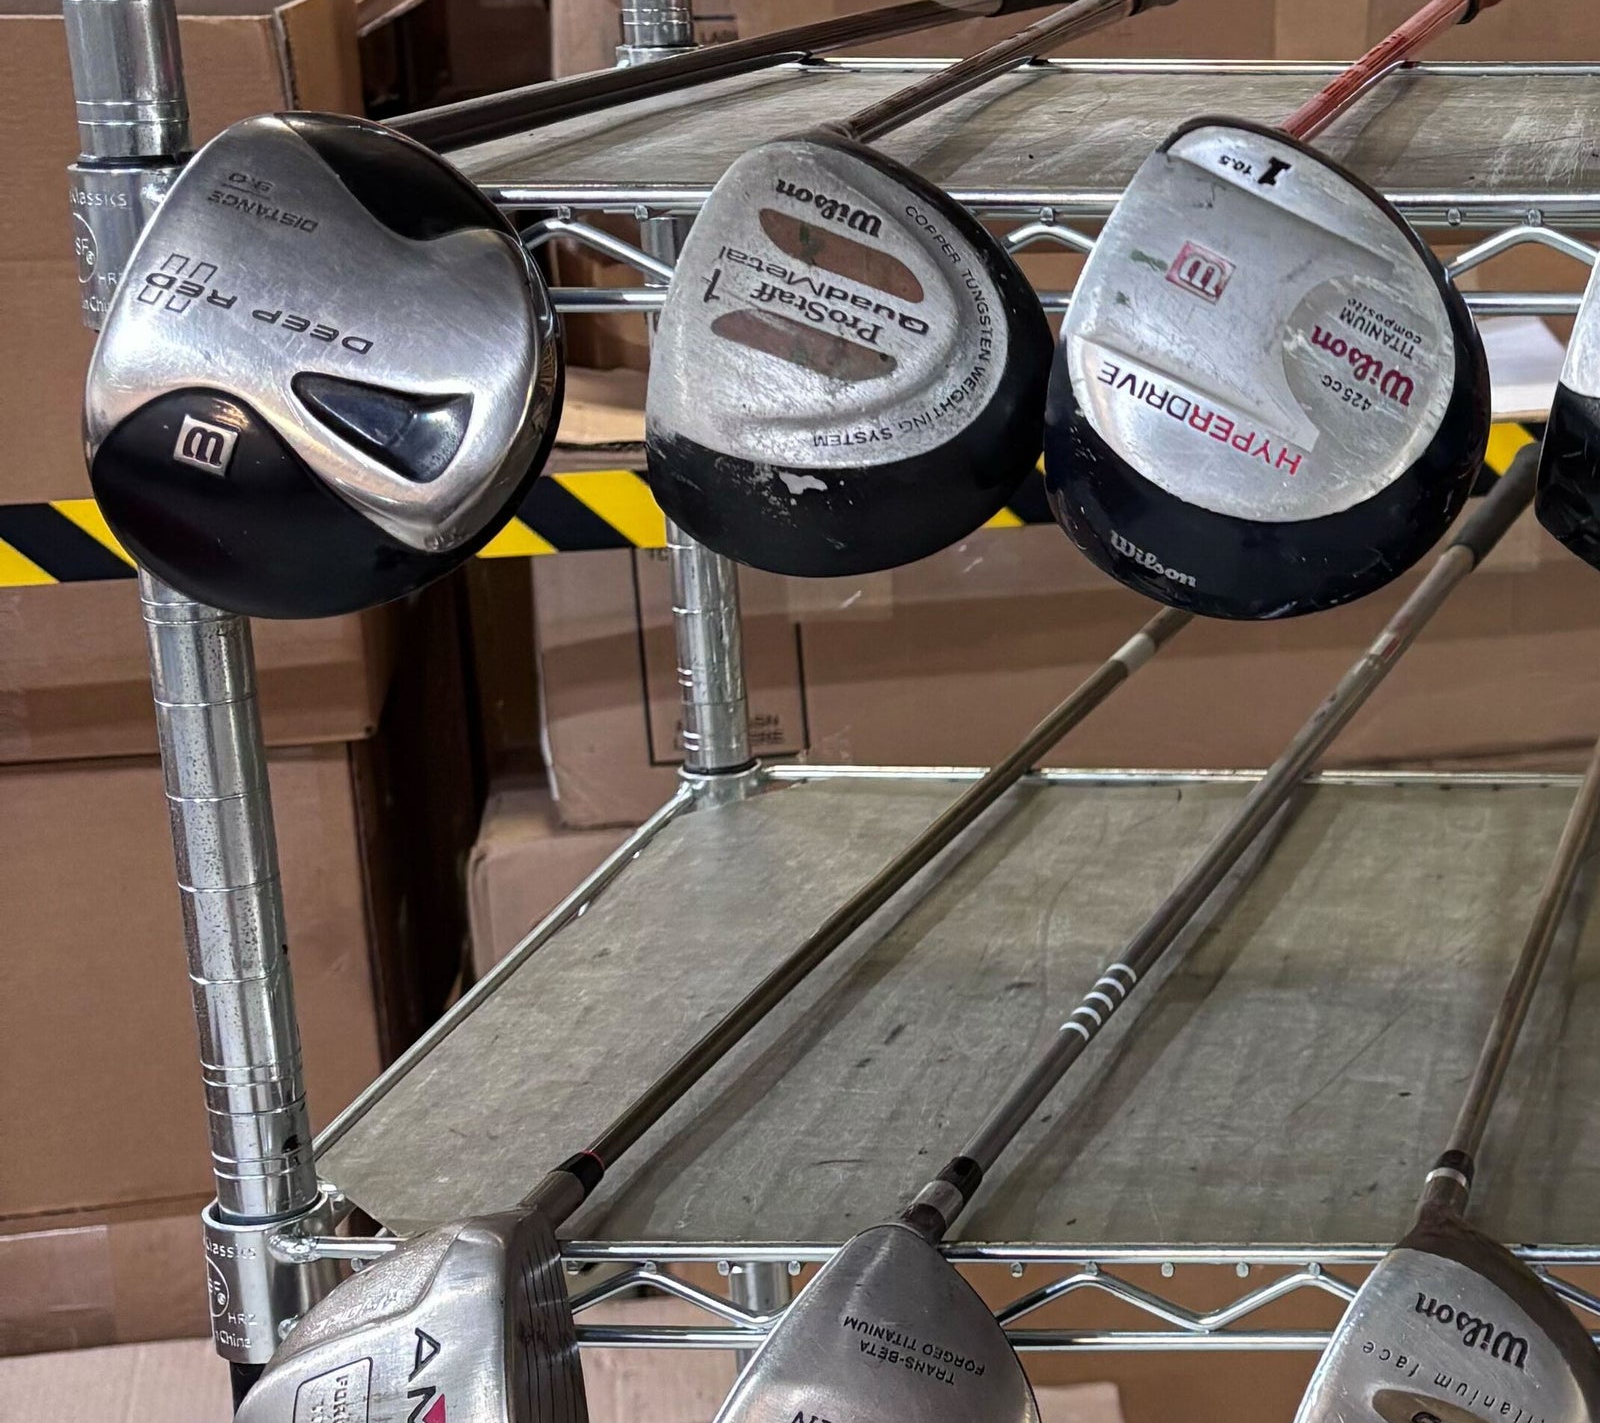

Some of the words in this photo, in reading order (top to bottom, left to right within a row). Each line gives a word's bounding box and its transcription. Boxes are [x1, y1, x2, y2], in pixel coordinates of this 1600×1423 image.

[1218, 154, 1252, 176] 10.5
[208, 189, 318, 233] DISTANCE
[775, 178, 881, 238] Wilson
[905, 205, 962, 264] COPPER
[146, 273, 237, 310] RED
[719, 244, 930, 336] QuadMetal
[749, 282, 882, 344] ProStaff
[961, 268, 994, 362] TUNGSTEN
[252, 309, 373, 355] DEEP
[1339, 305, 1415, 360] TITANIUM
[1347, 298, 1422, 345] composite
[1311, 325, 1414, 408] Wilson
[900, 364, 986, 436] WEIGHTING
[1099, 360, 1302, 476] HYPERDRIVE
[813, 427, 893, 448] SYSTEM
[1110, 530, 1197, 588] Wilson
[844, 1315, 917, 1349] TITANIUM
[1415, 1292, 1529, 1371] Wilson
[859, 1339, 955, 1385] TRANS-BETA
[921, 1343, 985, 1377] FORGED
[1363, 1341, 1424, 1378] face
